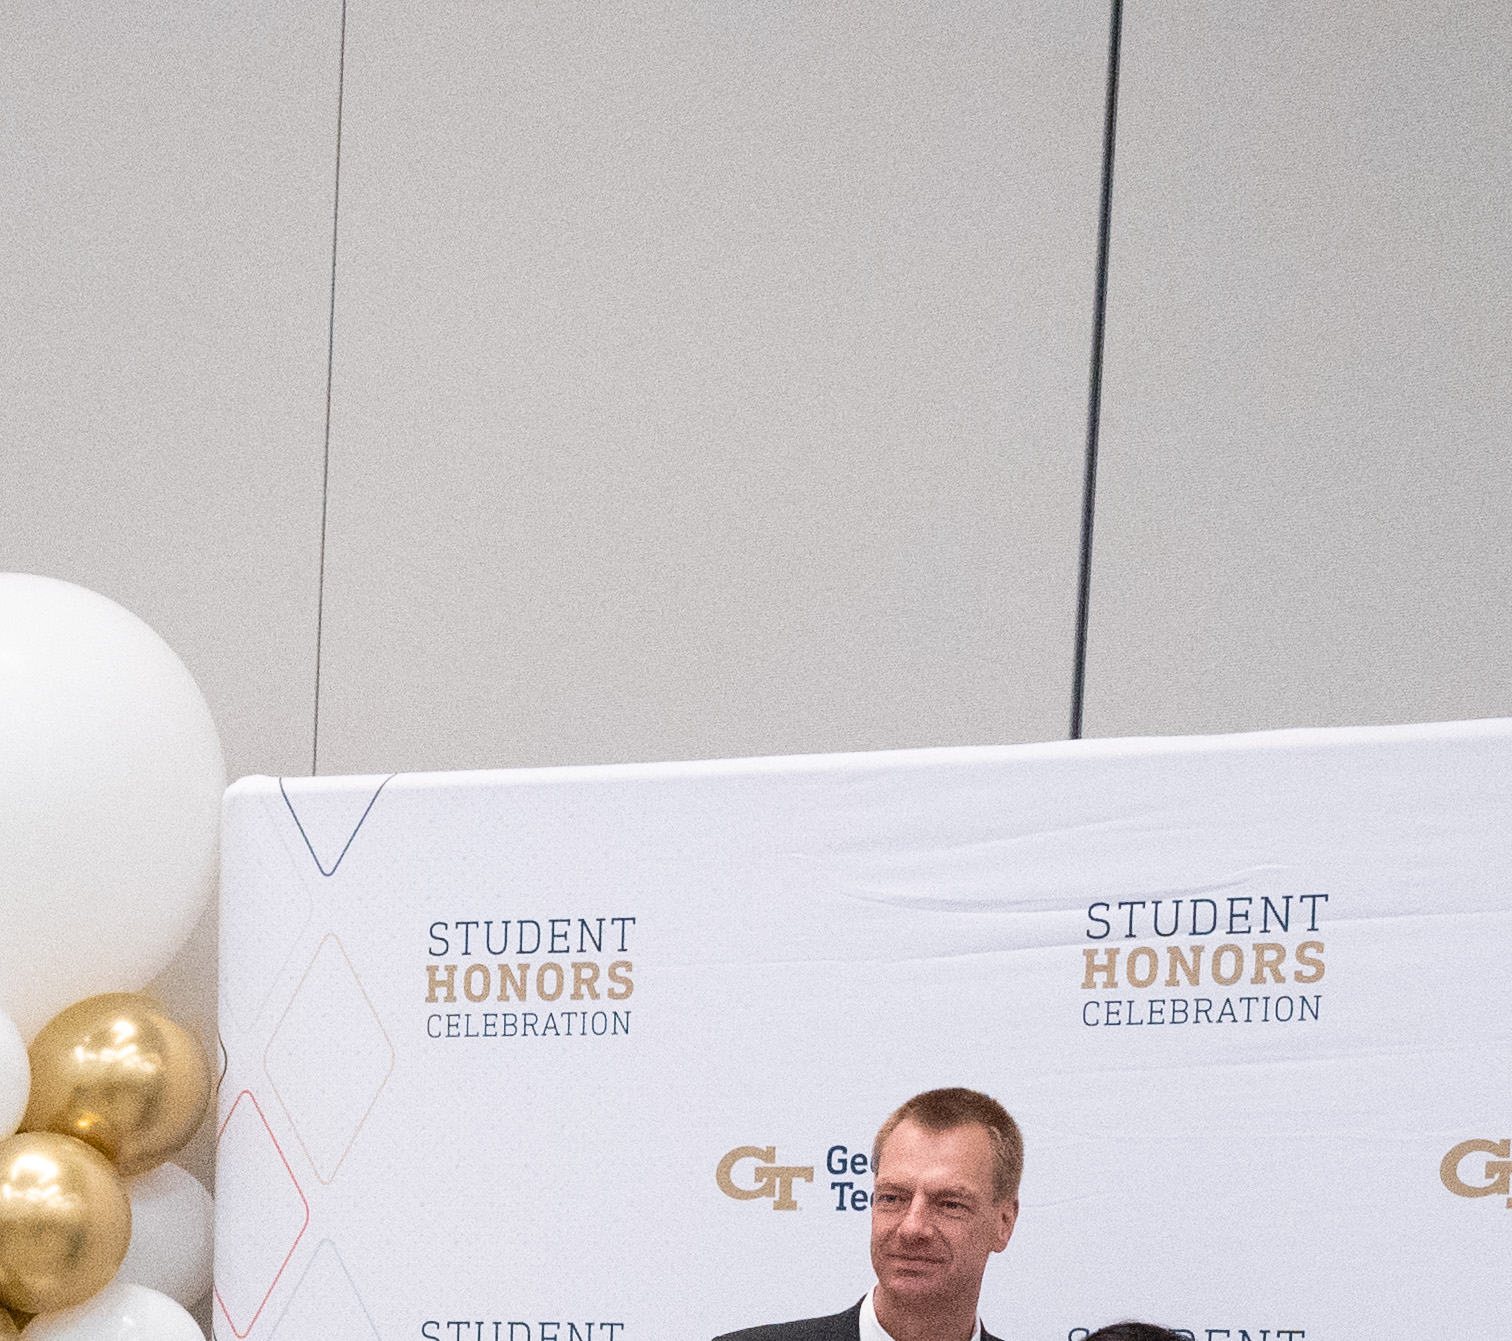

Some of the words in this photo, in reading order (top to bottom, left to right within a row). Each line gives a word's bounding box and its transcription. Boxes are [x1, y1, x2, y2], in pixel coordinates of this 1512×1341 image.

[429, 917, 636, 957] STUDENT
[1086, 894, 1329, 940] STUDENT
[427, 961, 633, 1002] HONORS
[1083, 942, 1325, 988] HONORS
[428, 1011, 630, 1037] CELEBRATION
[1083, 995, 1321, 1026] CELEBRATION
[716, 1146, 813, 1210] GT
